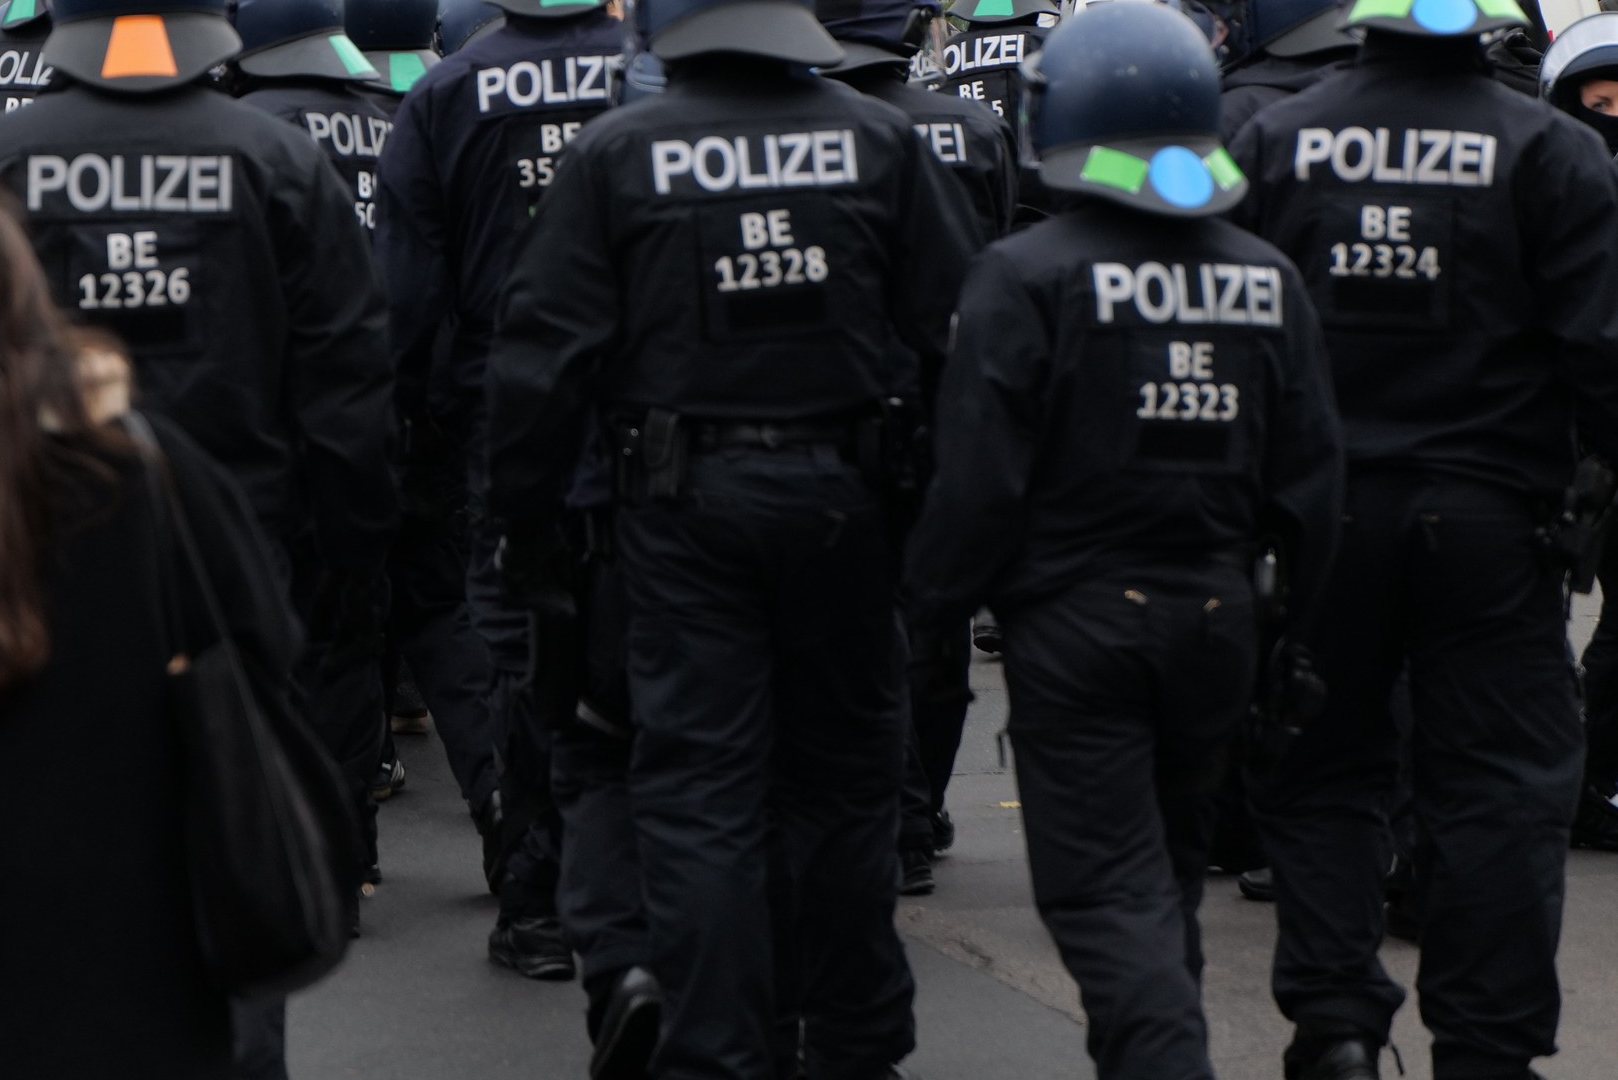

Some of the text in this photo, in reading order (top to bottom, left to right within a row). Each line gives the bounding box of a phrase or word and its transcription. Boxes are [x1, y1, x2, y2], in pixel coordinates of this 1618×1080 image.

[943, 34, 1026, 75] OLIZEI
[651, 129, 859, 195] POLIZEI
[1294, 125, 1497, 188] POLIZEI
[27, 152, 233, 213] POLIZEI
[740, 209, 795, 250] BE
[1360, 205, 1413, 241] BE
[106, 230, 159, 270] BE
[714, 245, 829, 292] 12328
[1329, 242, 1442, 280] 12324
[78, 267, 191, 310] 12326
[1092, 261, 1283, 328] POLIZEI
[1168, 340, 1215, 380] BE
[1136, 381, 1240, 422] 12323
